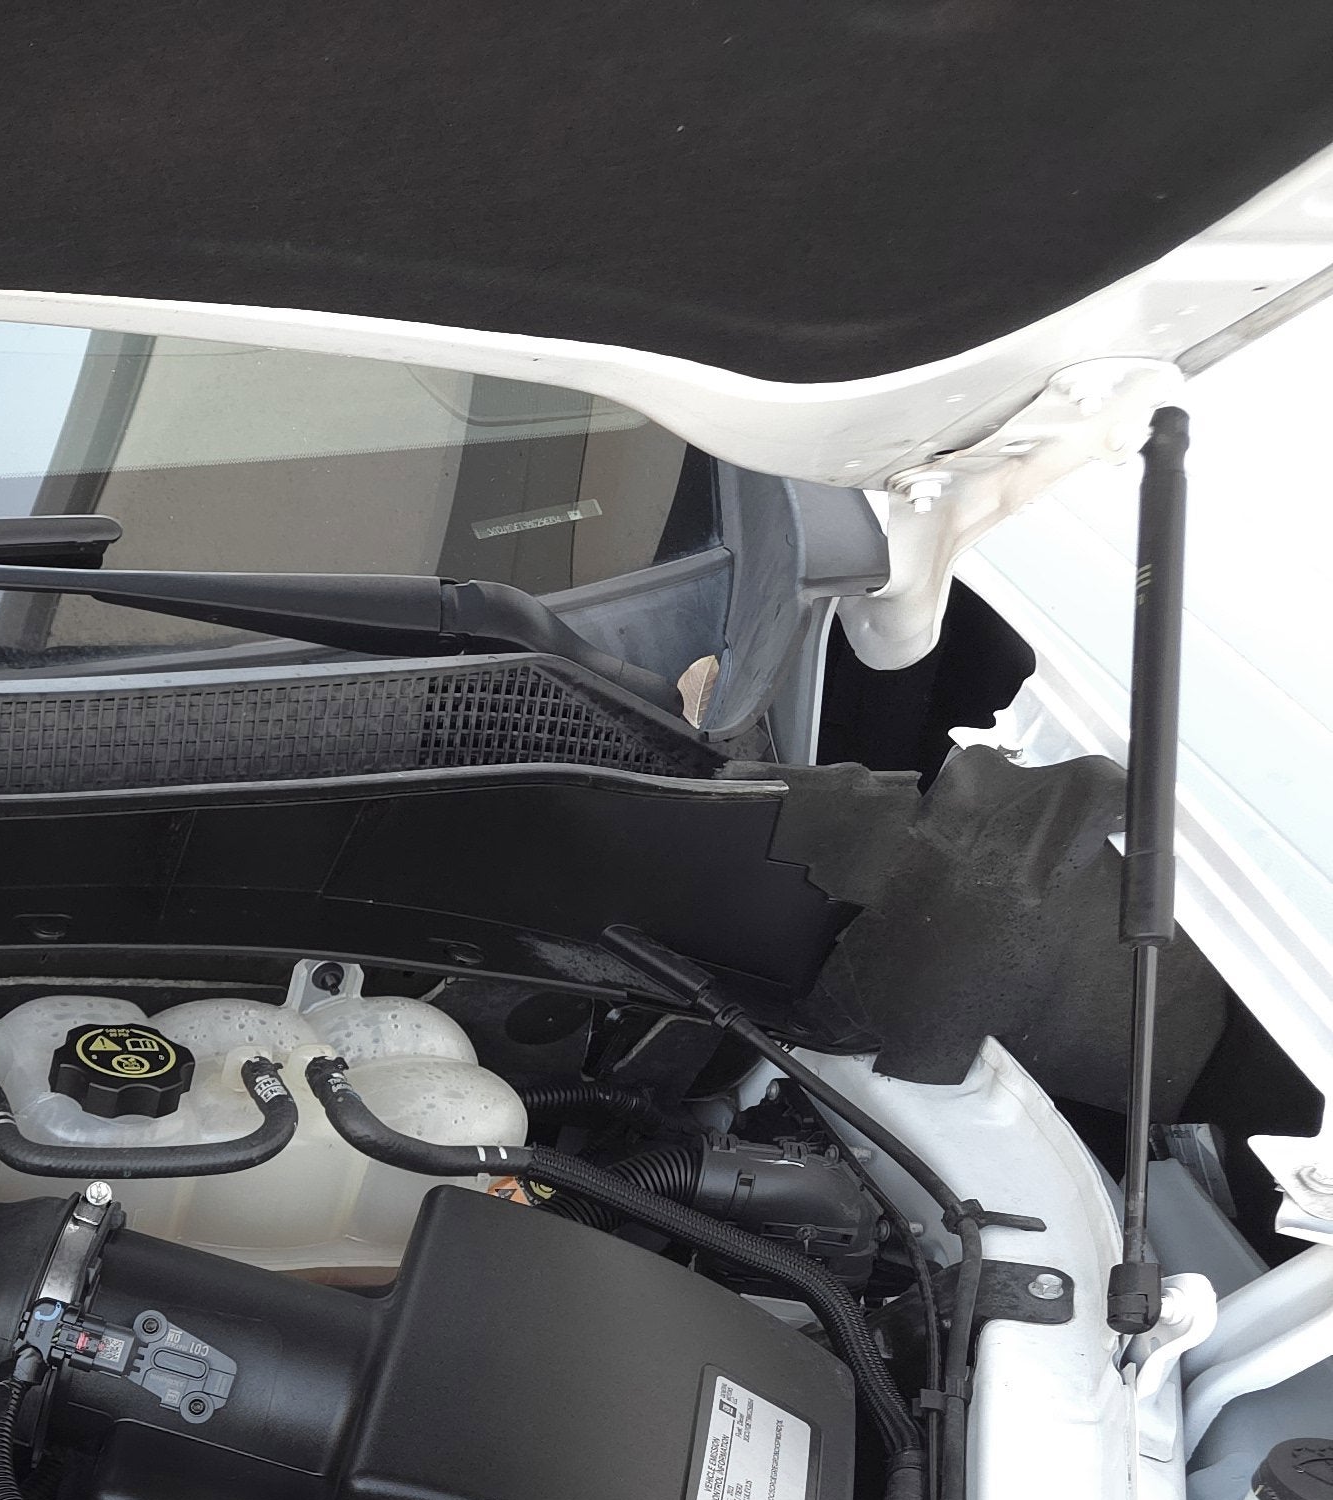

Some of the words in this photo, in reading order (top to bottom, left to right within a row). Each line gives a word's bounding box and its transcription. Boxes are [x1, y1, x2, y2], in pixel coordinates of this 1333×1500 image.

[708, 1435, 720, 1466] EMISSION
[716, 1433, 729, 1475] INFORMATION
[704, 1465, 715, 1492] VEHICLE
